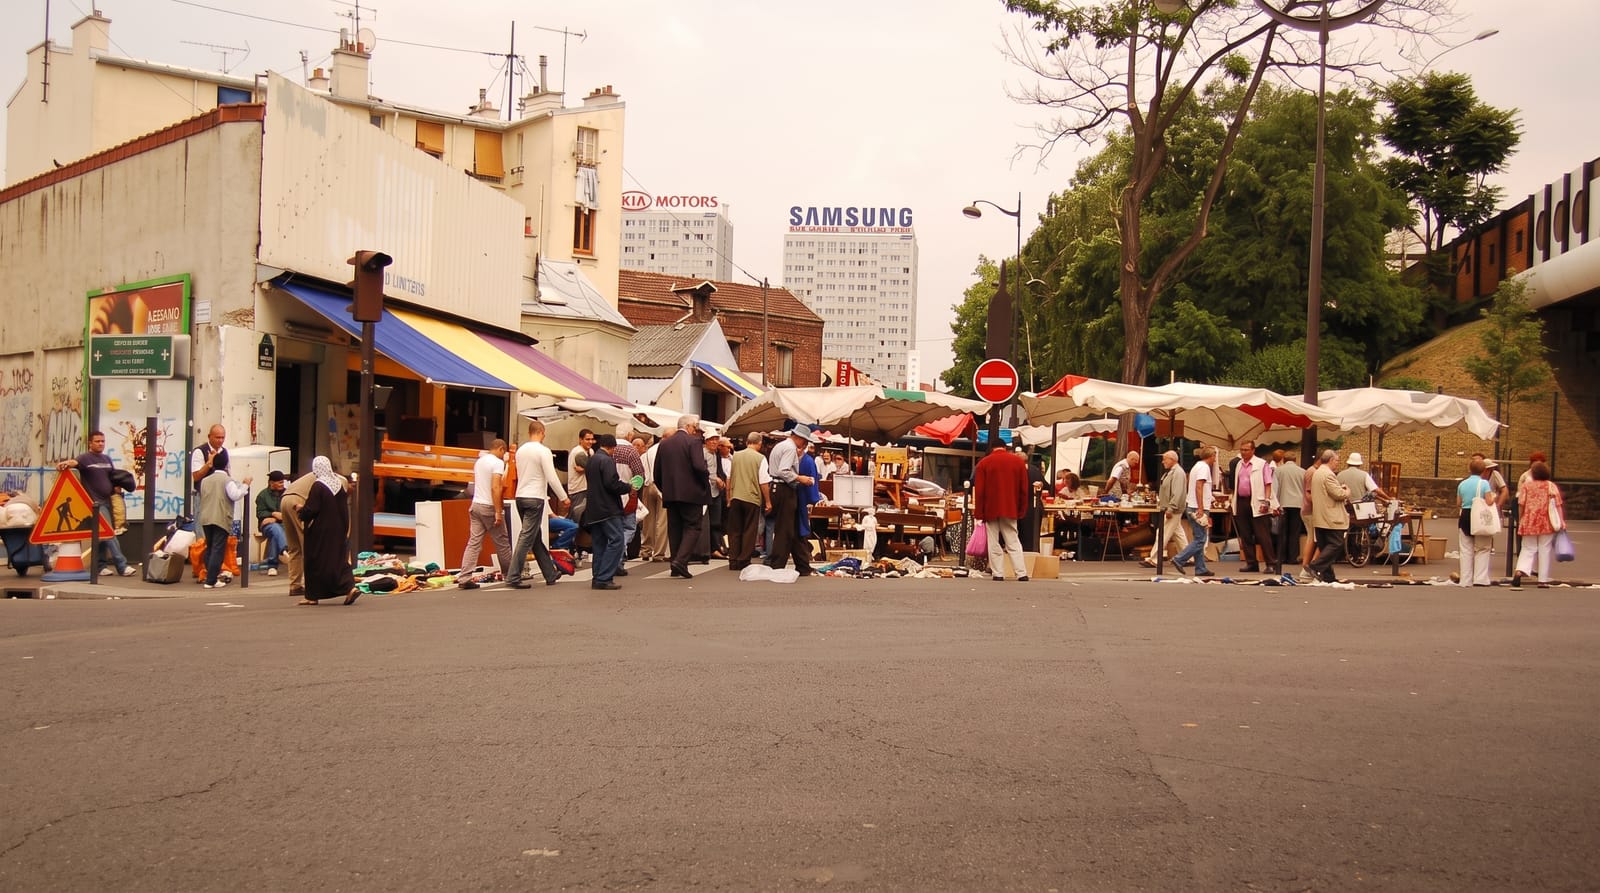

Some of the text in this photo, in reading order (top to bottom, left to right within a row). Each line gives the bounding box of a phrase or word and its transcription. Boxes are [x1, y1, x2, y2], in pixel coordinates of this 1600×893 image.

[621, 196, 718, 208] KIA MOTORS
[789, 206, 912, 227] SAMSUNG
